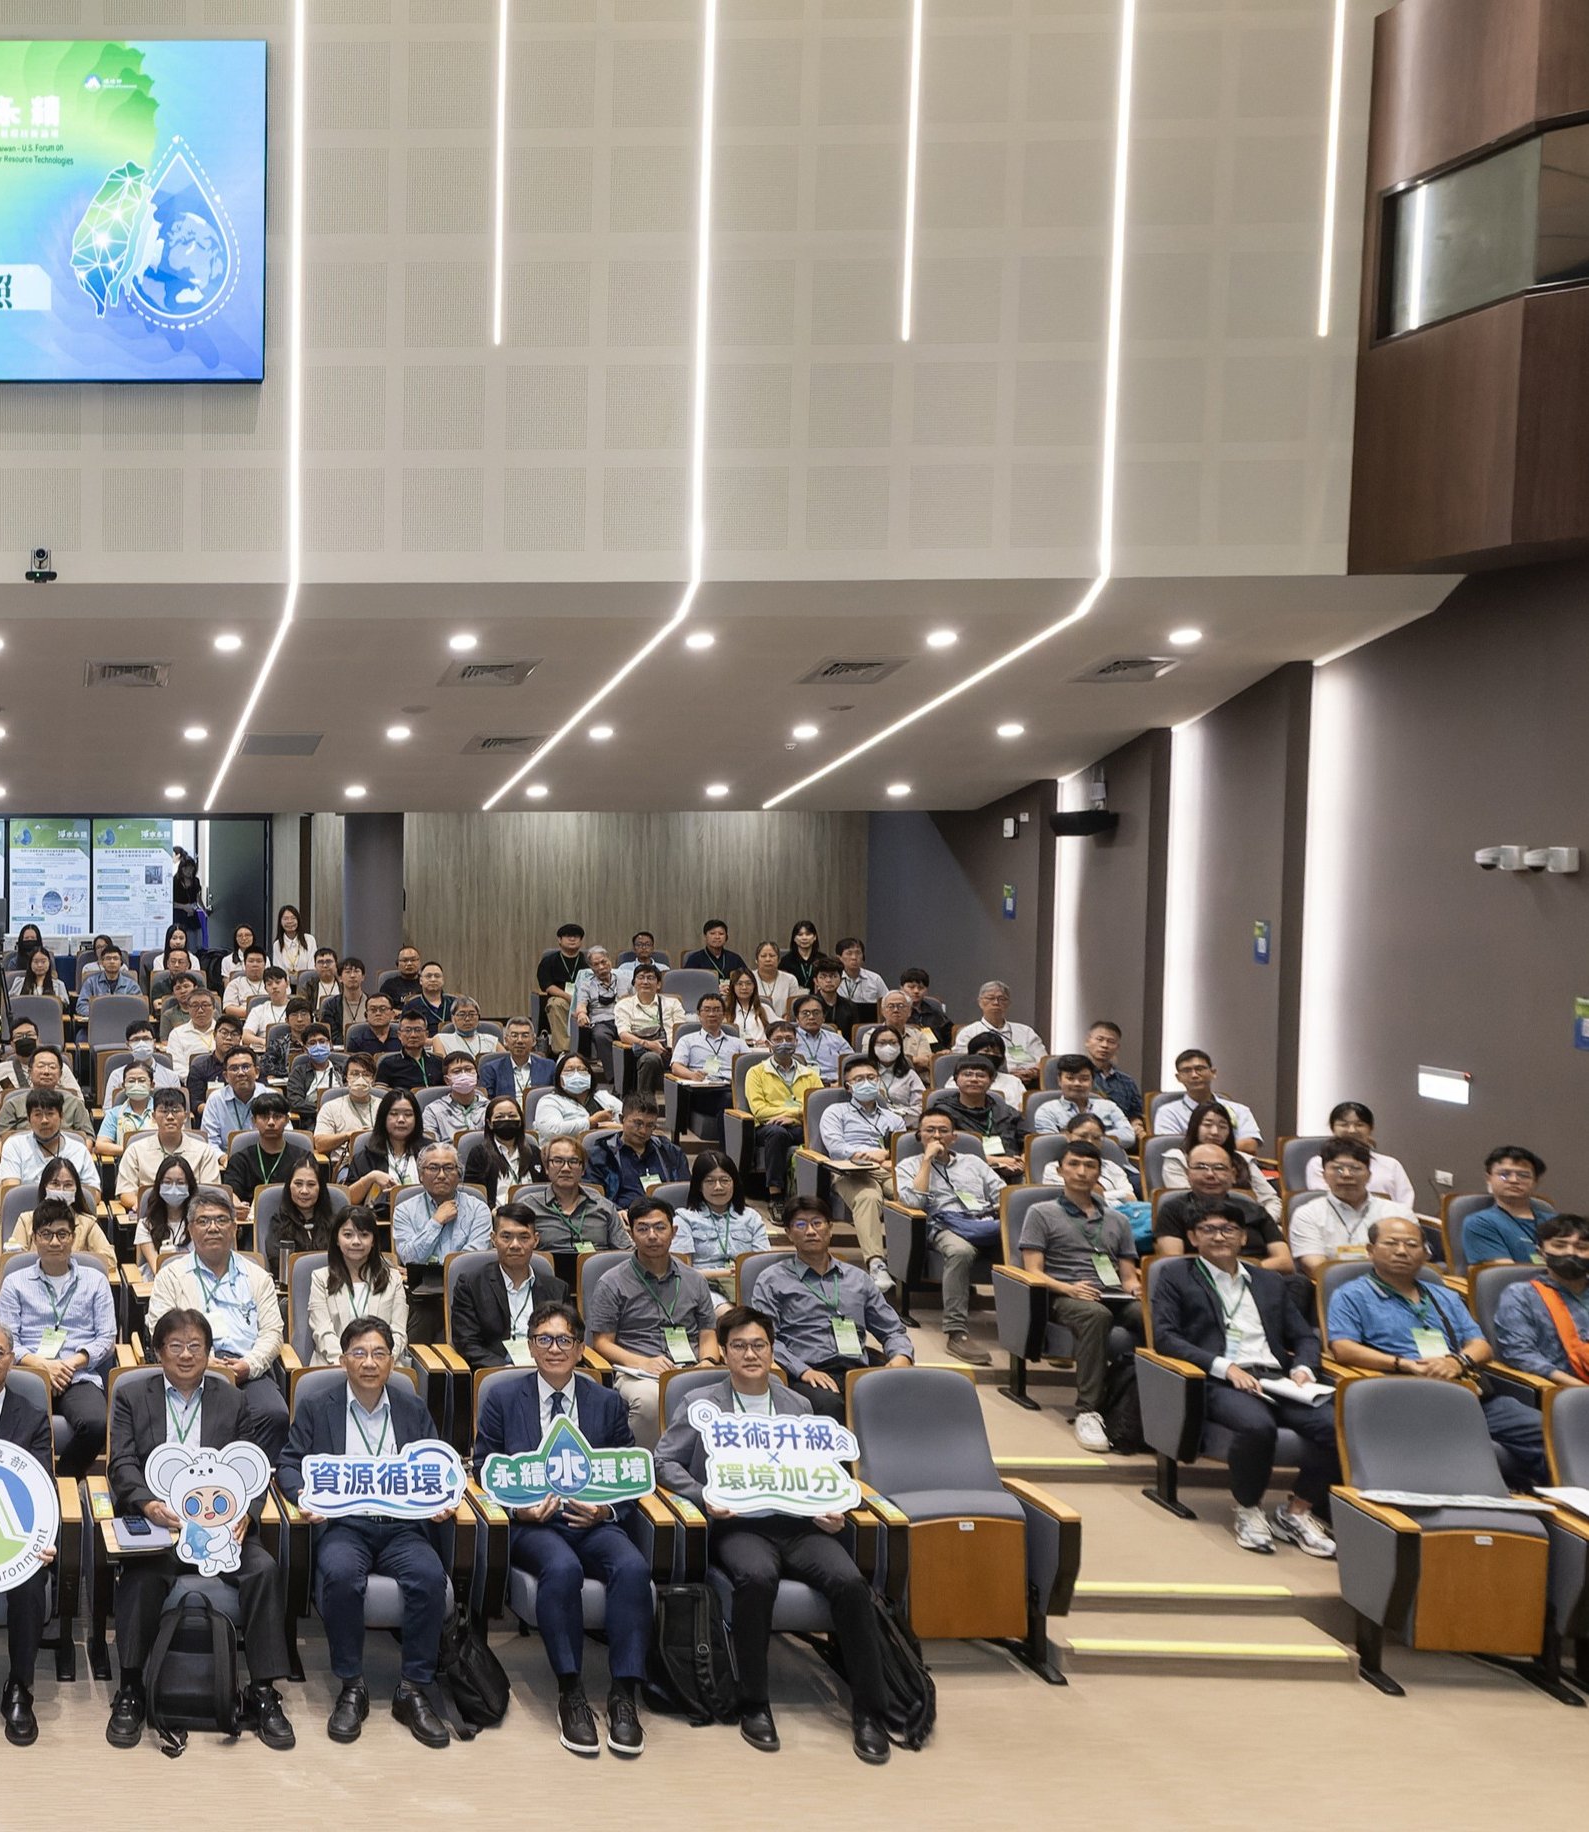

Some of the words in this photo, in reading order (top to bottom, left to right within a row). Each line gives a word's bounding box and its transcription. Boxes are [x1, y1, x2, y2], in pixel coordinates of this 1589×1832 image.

[34, 156, 74, 167] Technologies
[35, 143, 54, 152] Forum
[711, 1420, 835, 1451] 技術升級
[310, 1462, 443, 1495] 資源循環
[491, 1448, 648, 1488] 永續水環境
[716, 1463, 840, 1493] 環境加分
